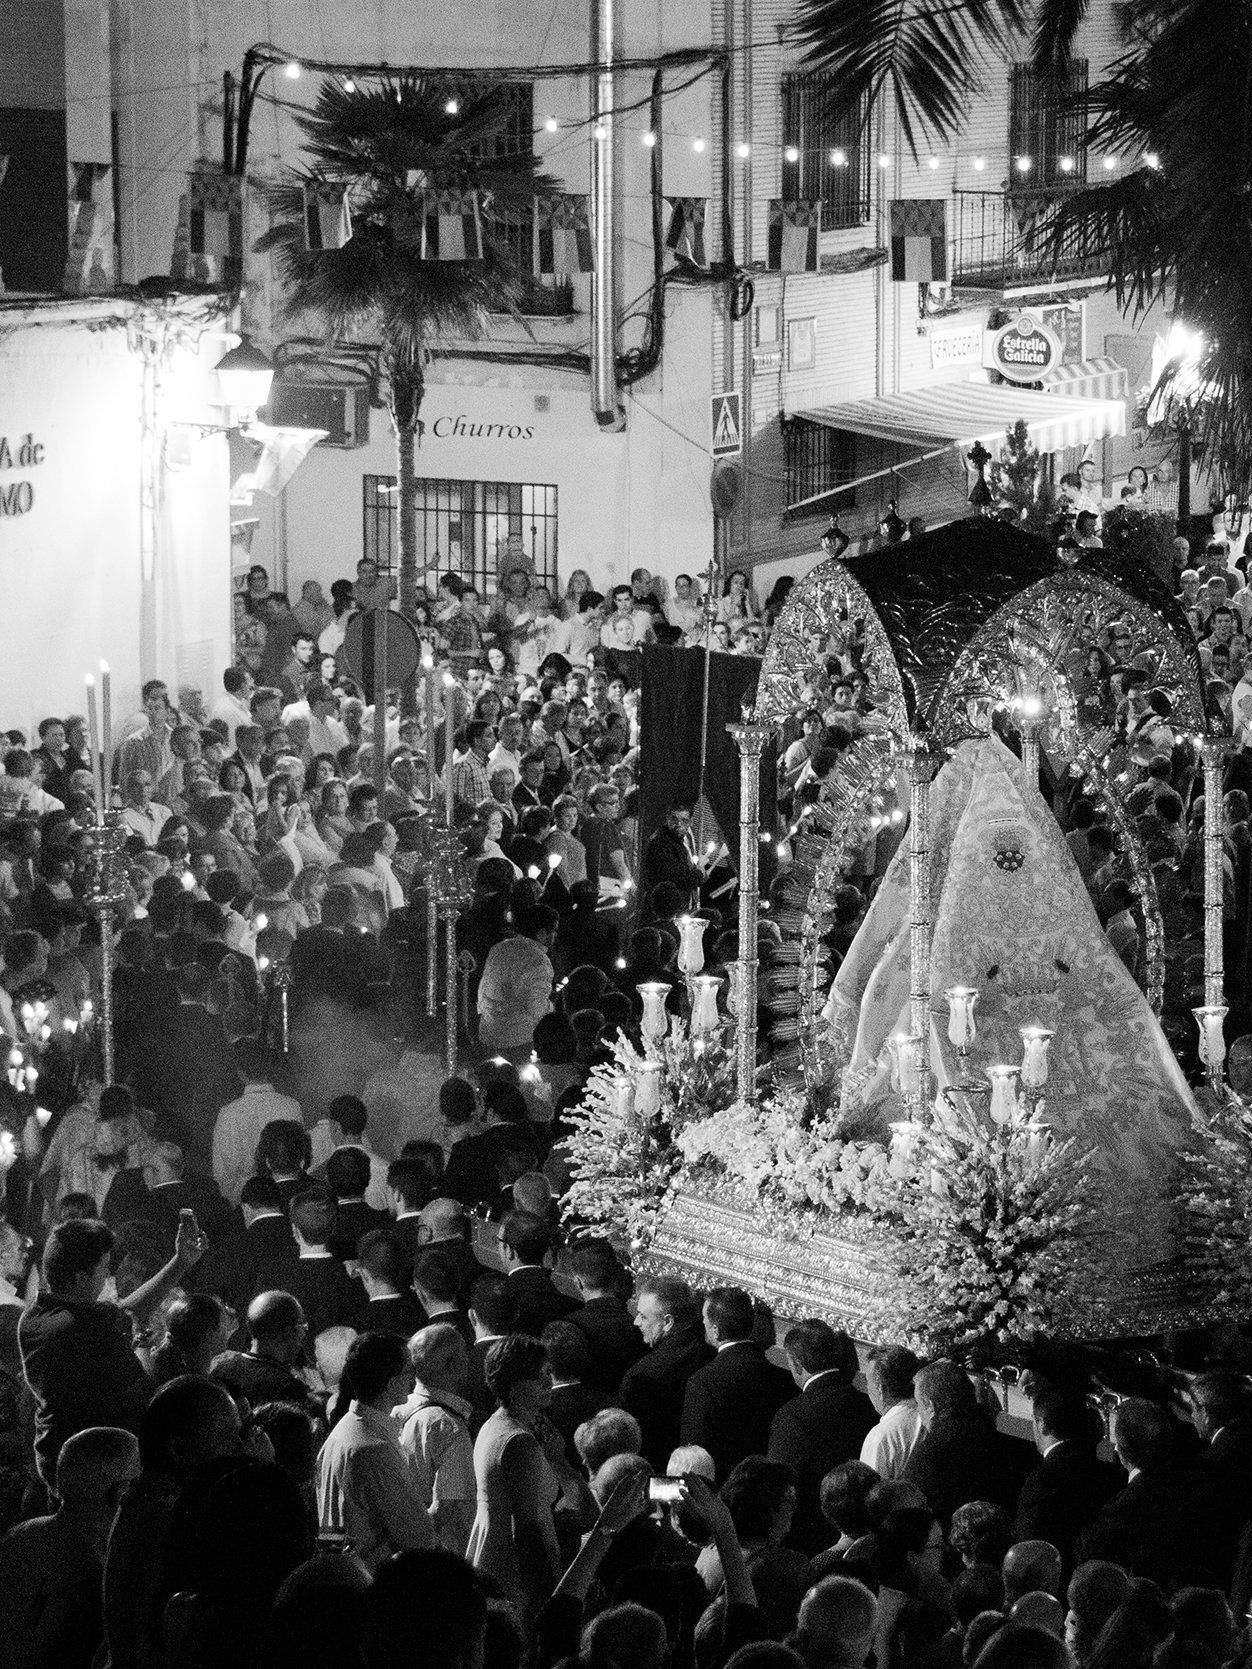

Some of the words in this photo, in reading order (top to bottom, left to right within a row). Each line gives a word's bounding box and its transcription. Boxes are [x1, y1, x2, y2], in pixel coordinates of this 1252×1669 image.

[1002, 335, 1047, 352] Estrella
[1004, 347, 1045, 363] Galicia
[433, 415, 534, 440] Churros
